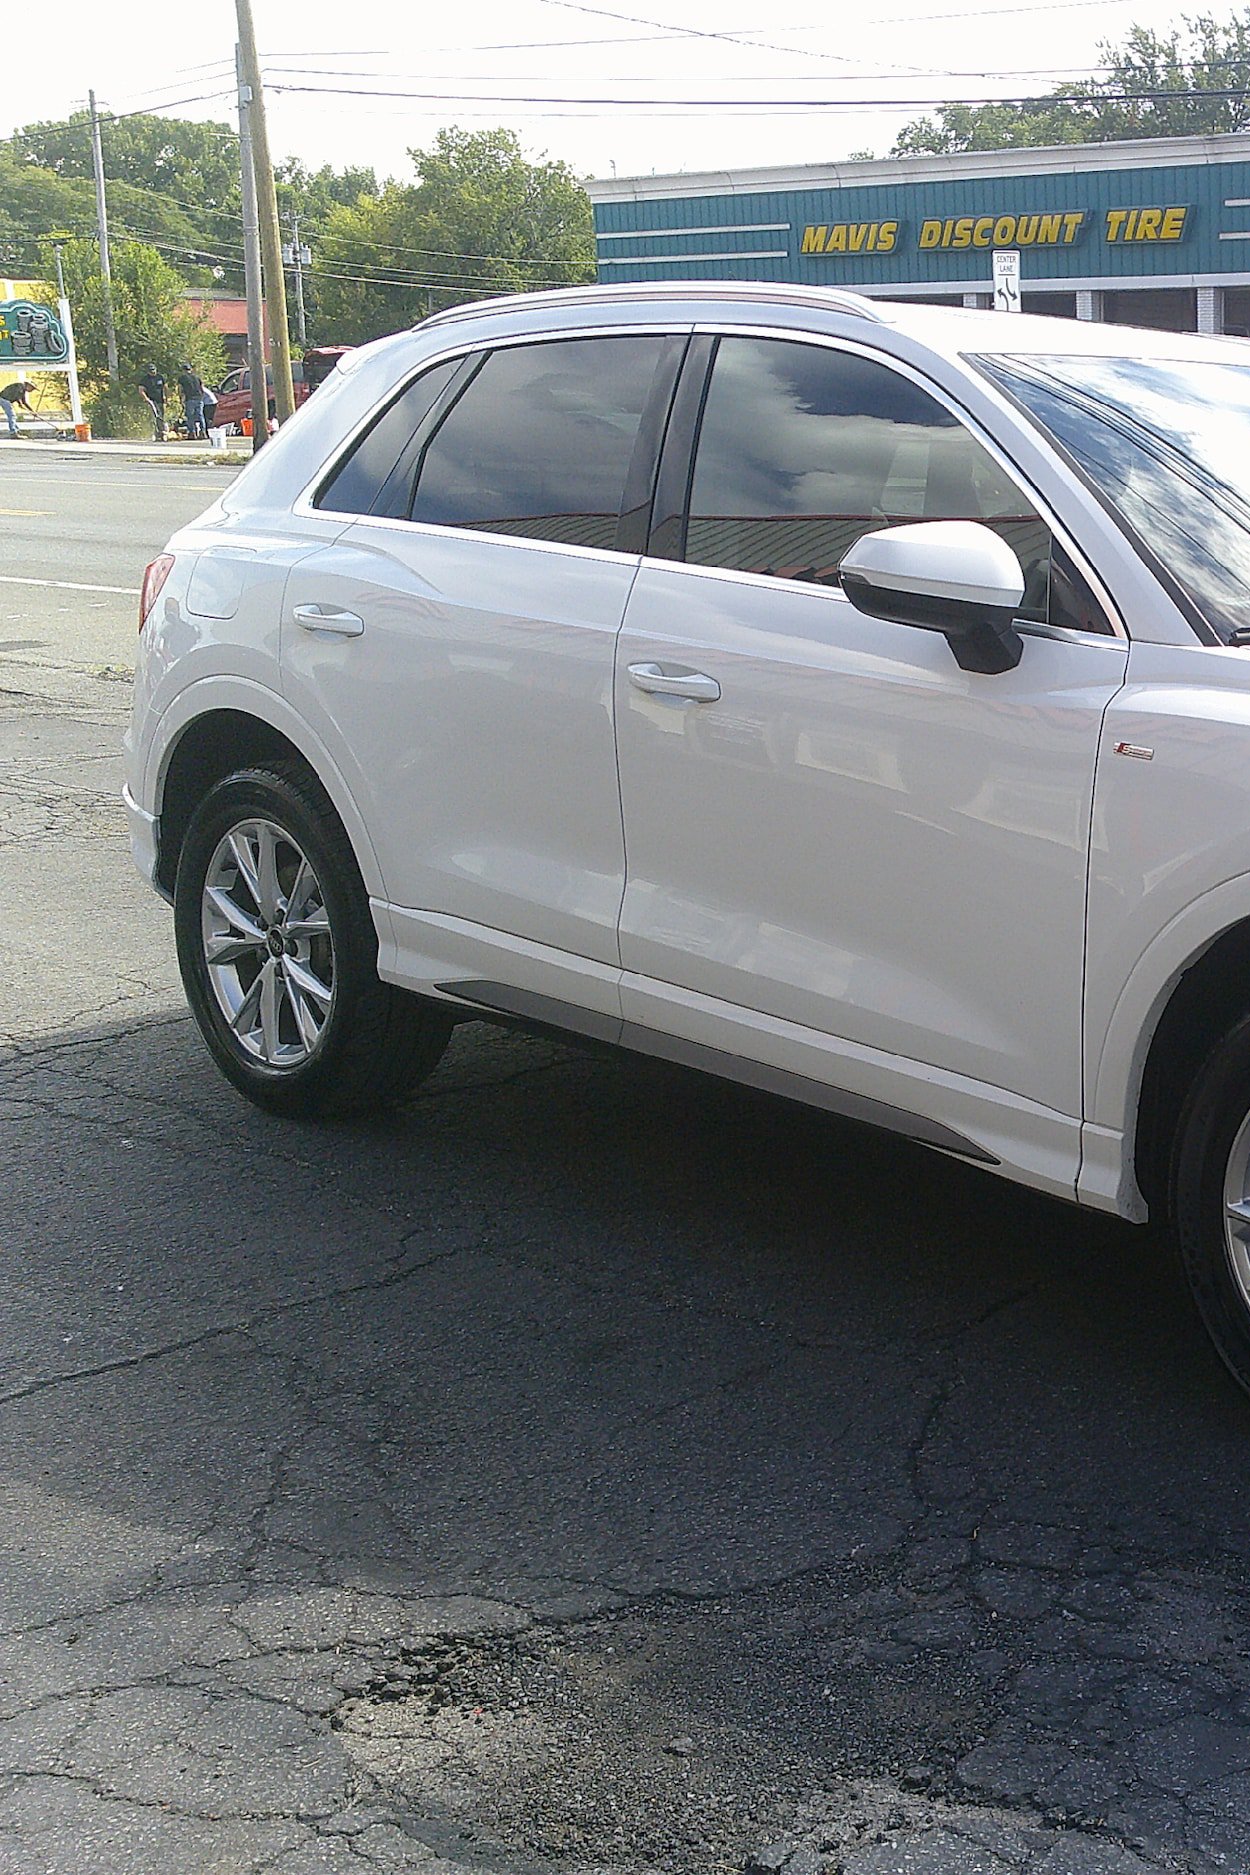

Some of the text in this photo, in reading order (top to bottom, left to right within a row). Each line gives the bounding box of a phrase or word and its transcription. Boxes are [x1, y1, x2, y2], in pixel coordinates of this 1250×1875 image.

[800, 206, 1188, 254] MAVIS DISCOUNT TIRE
[996, 255, 1017, 263] CENTER
